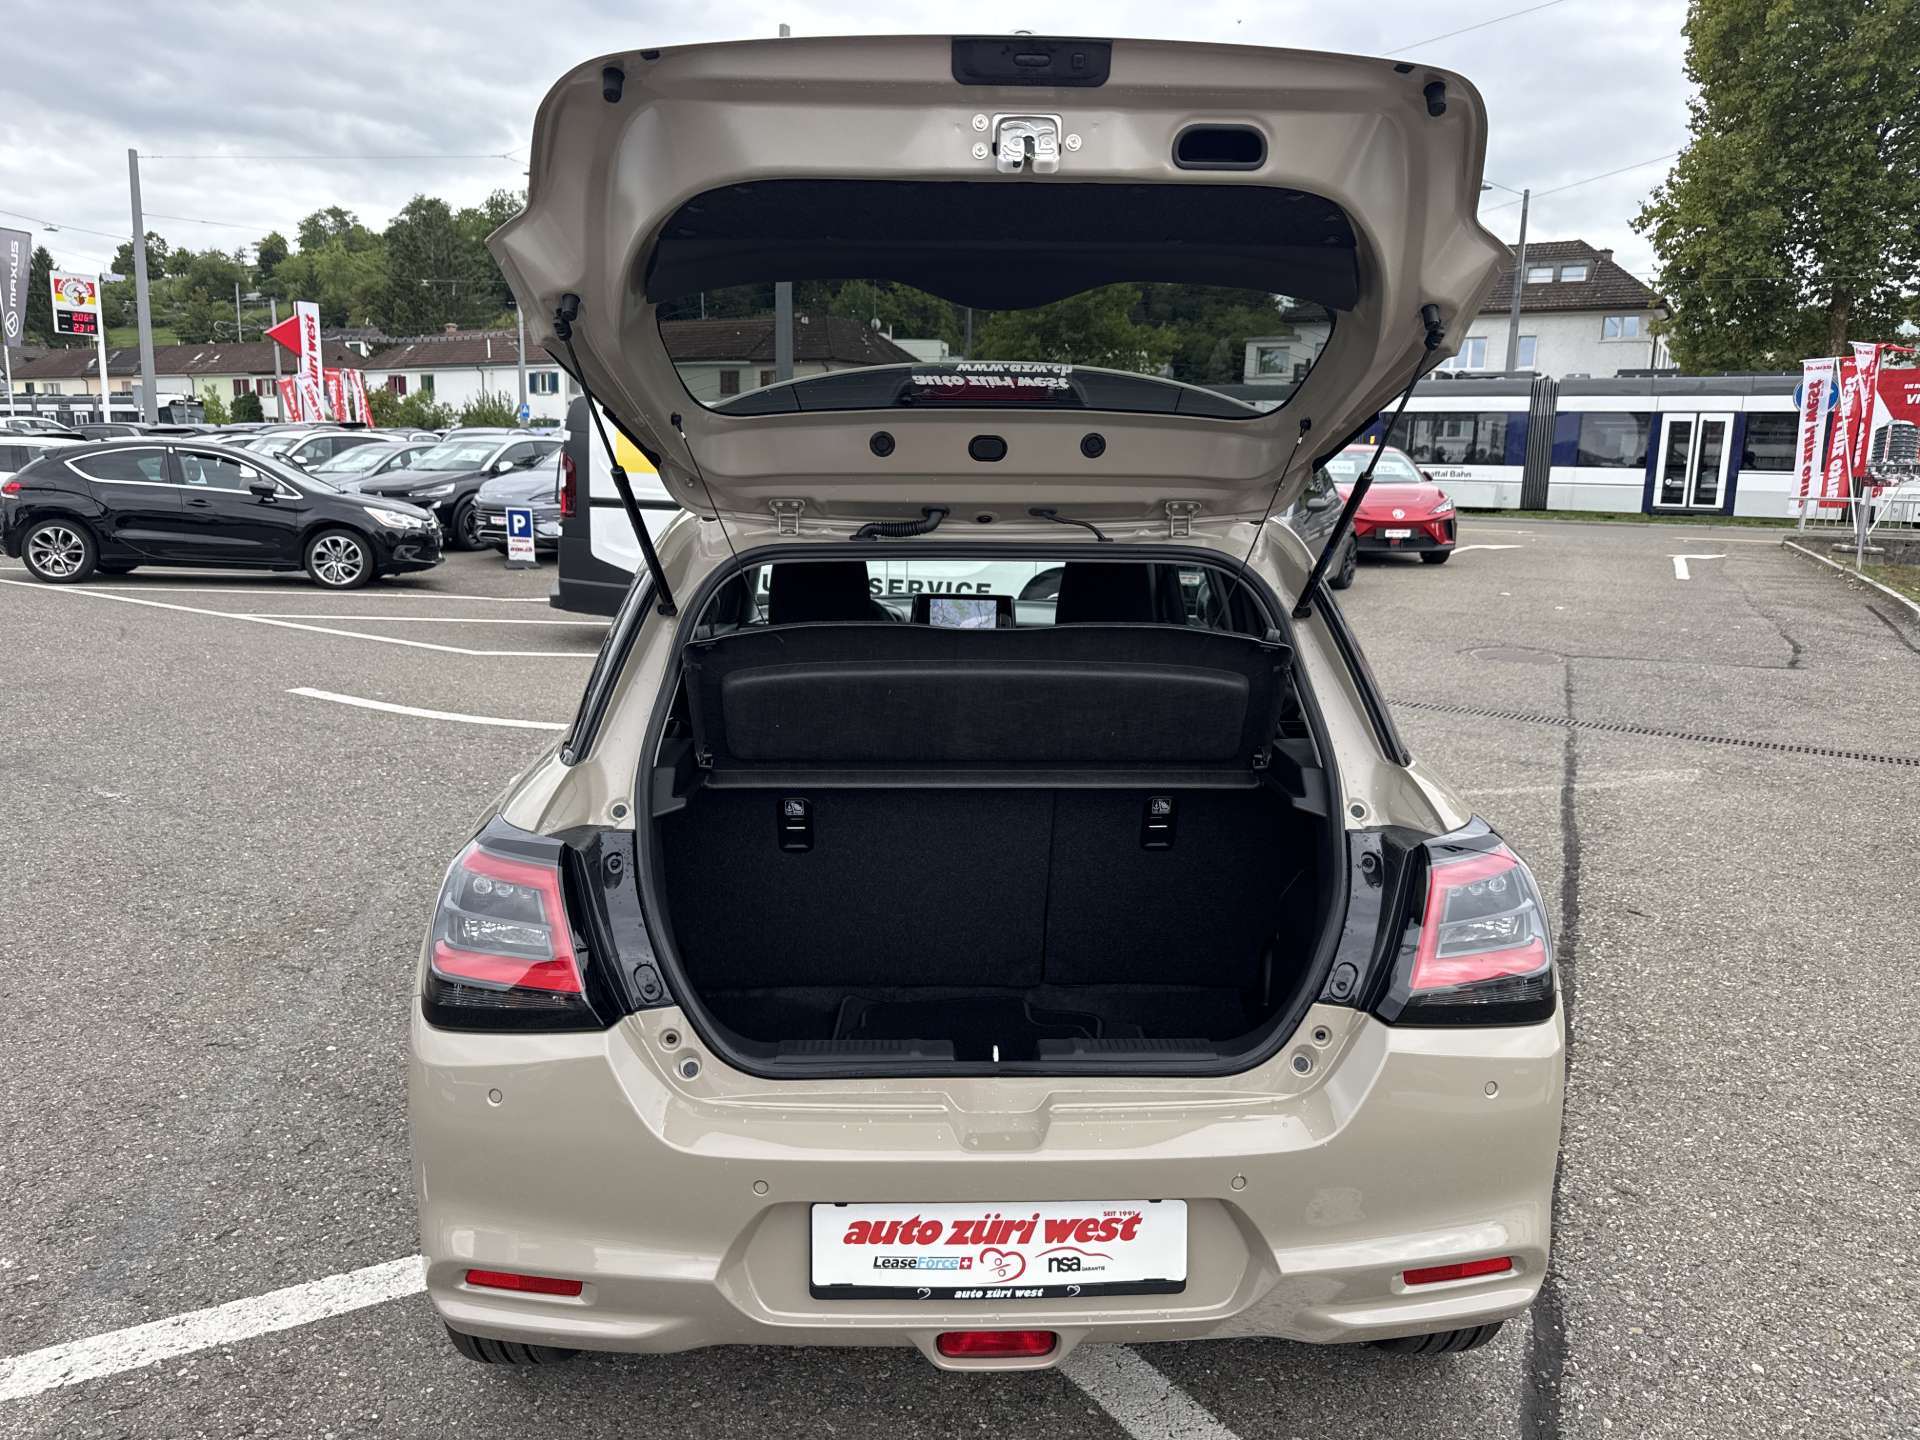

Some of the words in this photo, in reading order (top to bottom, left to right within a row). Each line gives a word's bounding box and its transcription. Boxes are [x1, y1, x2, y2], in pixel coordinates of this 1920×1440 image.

[9, 239, 19, 308] MAXUS
[305, 313, 317, 352] west
[1450, 470, 1472, 478] Bahn
[512, 514, 526, 534] P
[869, 577, 992, 595] SERVICE
[843, 1214, 943, 1245] auto
[944, 1212, 1040, 1245] züri
[1045, 1212, 1143, 1243] west
[873, 1256, 959, 1269] LeaseForce
[1048, 1256, 1081, 1273] nsa
[954, 1289, 984, 1298] auto
[985, 1288, 1013, 1298] züri
[1015, 1287, 1044, 1298] west
